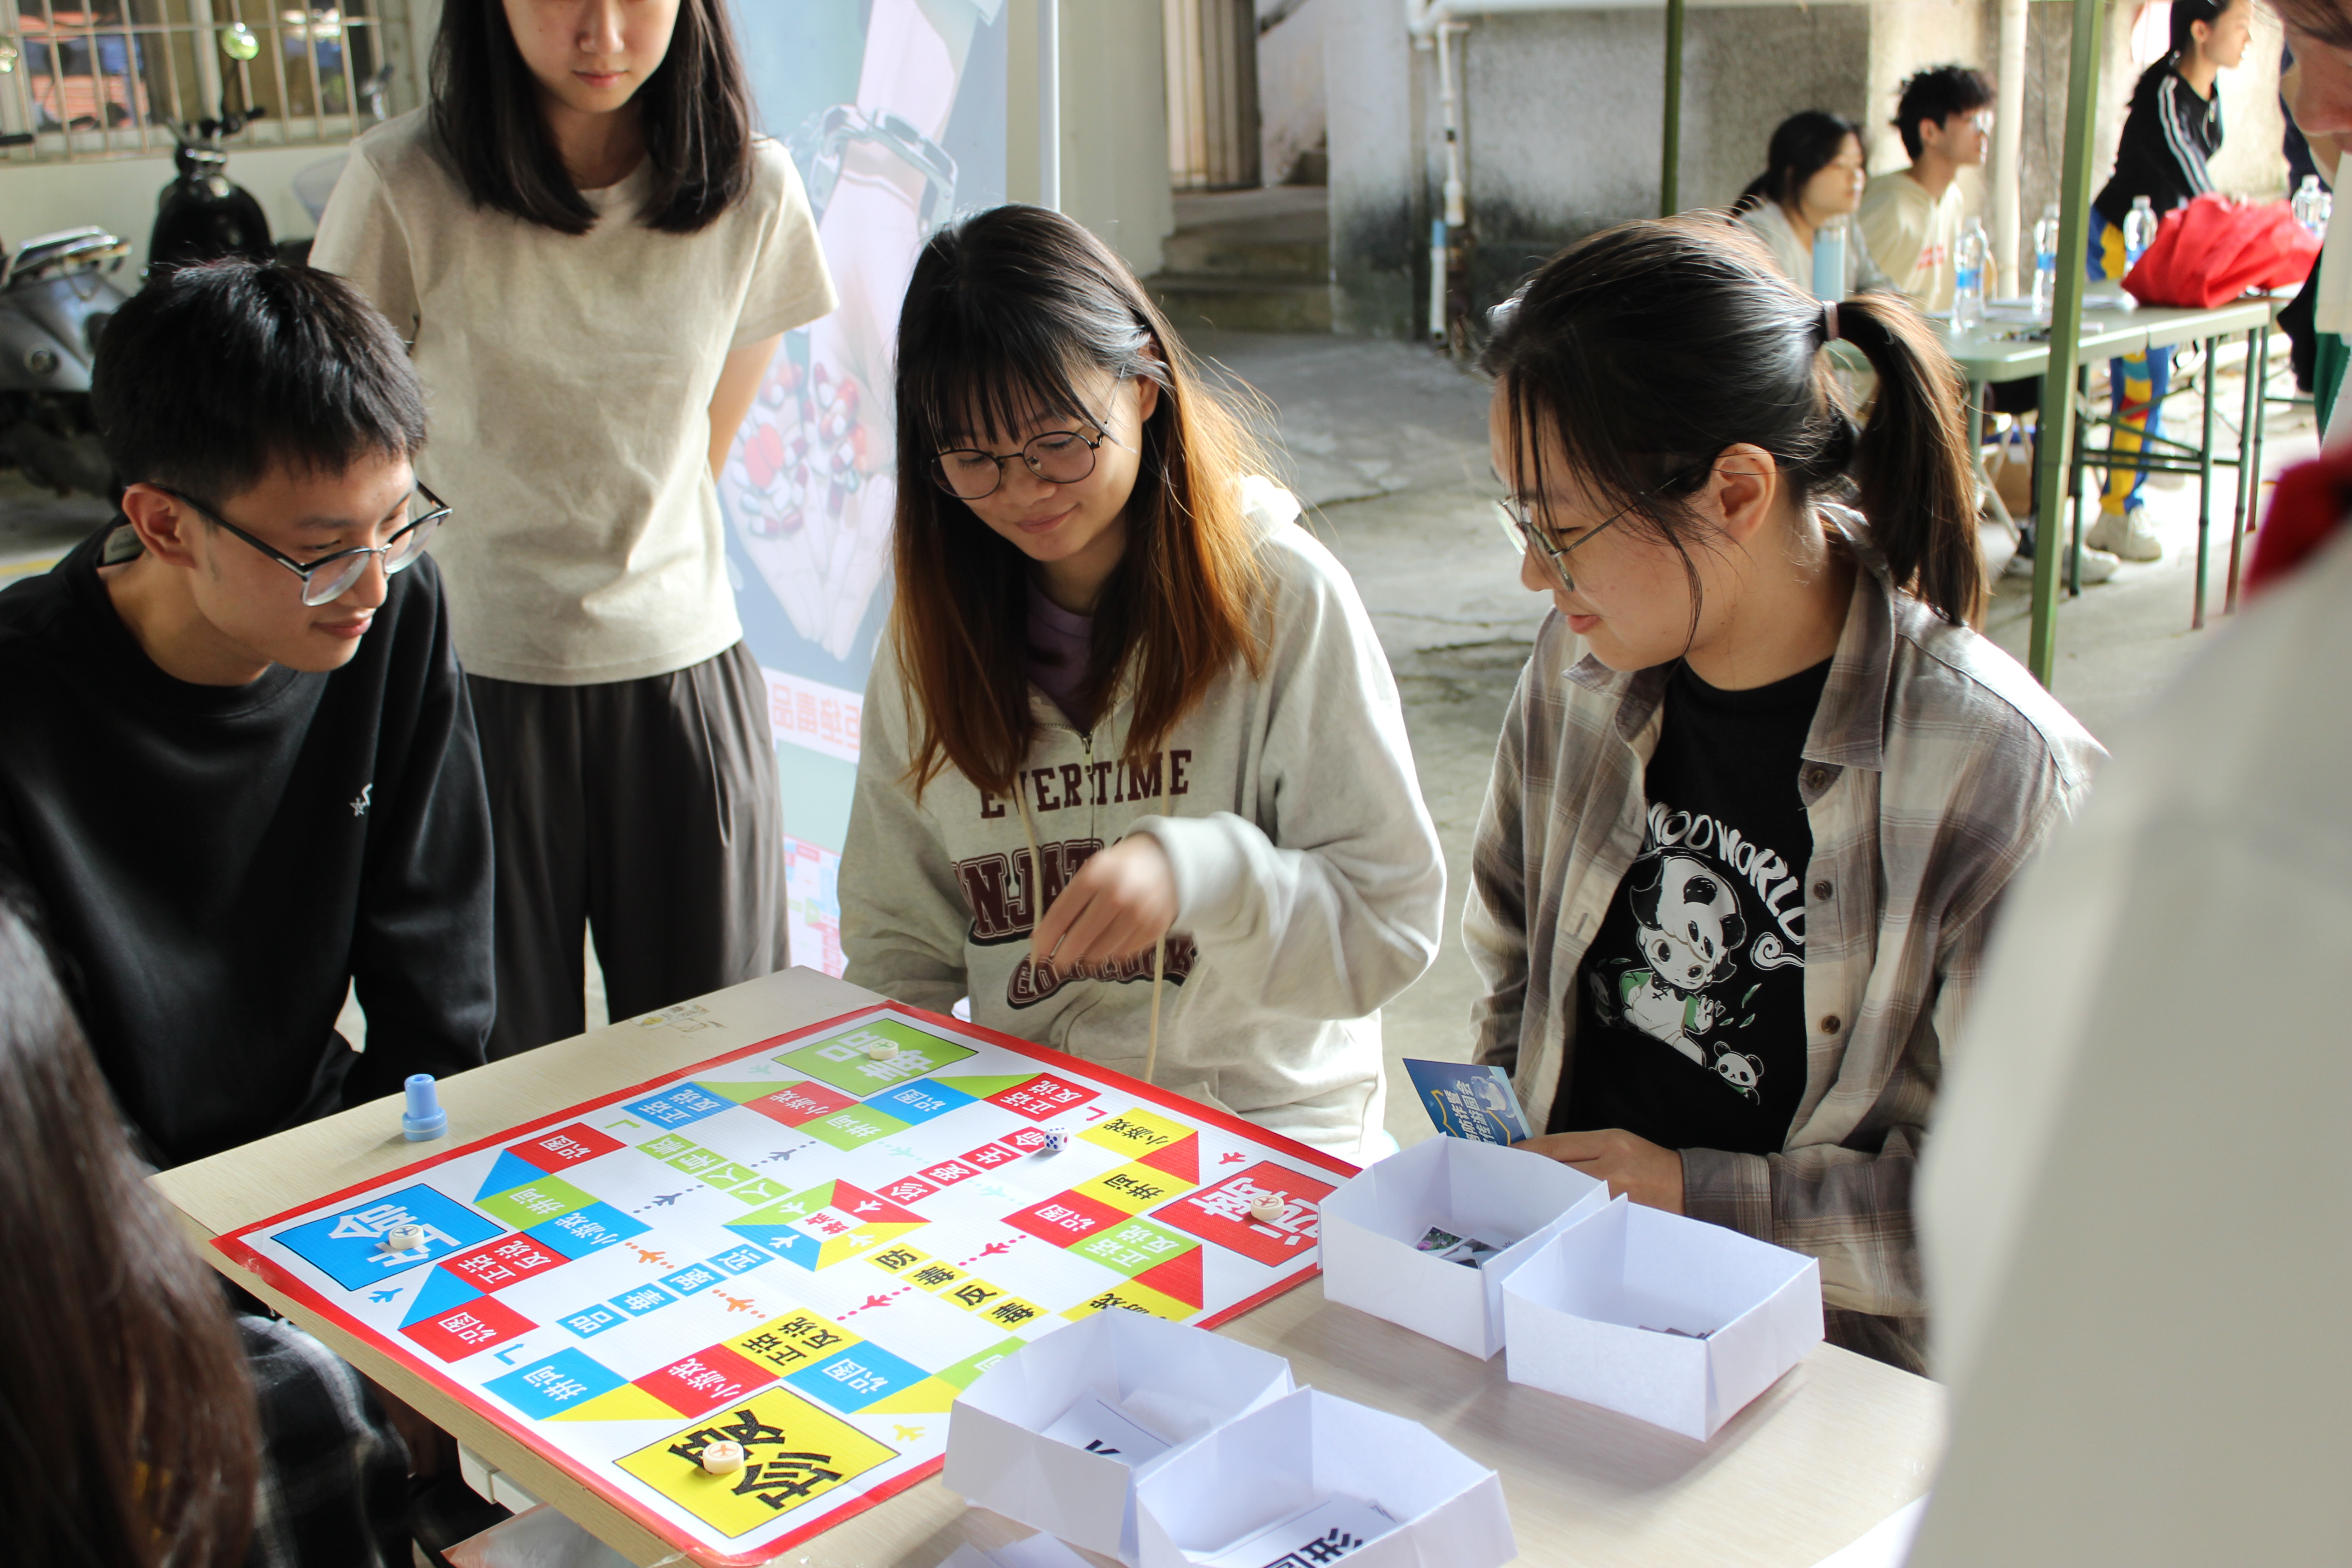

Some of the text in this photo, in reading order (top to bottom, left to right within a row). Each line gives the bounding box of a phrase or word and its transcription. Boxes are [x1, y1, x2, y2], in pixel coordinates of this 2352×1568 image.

[769, 1090, 829, 1115] 小游戏
[892, 1088, 946, 1112] 识图
[826, 1114, 882, 1137] 拼词
[1103, 1118, 1168, 1145] 小游戏
[539, 1135, 591, 1160] 识图
[1102, 1174, 1164, 1200] 拼词
[509, 1188, 566, 1215] 拼词
[554, 1212, 619, 1245] 小游戏
[805, 1213, 849, 1235] 终点
[1034, 1204, 1096, 1232] 识图
[328, 1204, 462, 1267] 生命
[438, 1312, 497, 1344] 识图
[522, 1365, 588, 1401] 拼词
[668, 1353, 742, 1398] 小游戏
[822, 1358, 888, 1394] 识图
[668, 1409, 844, 1510] 珍爱
